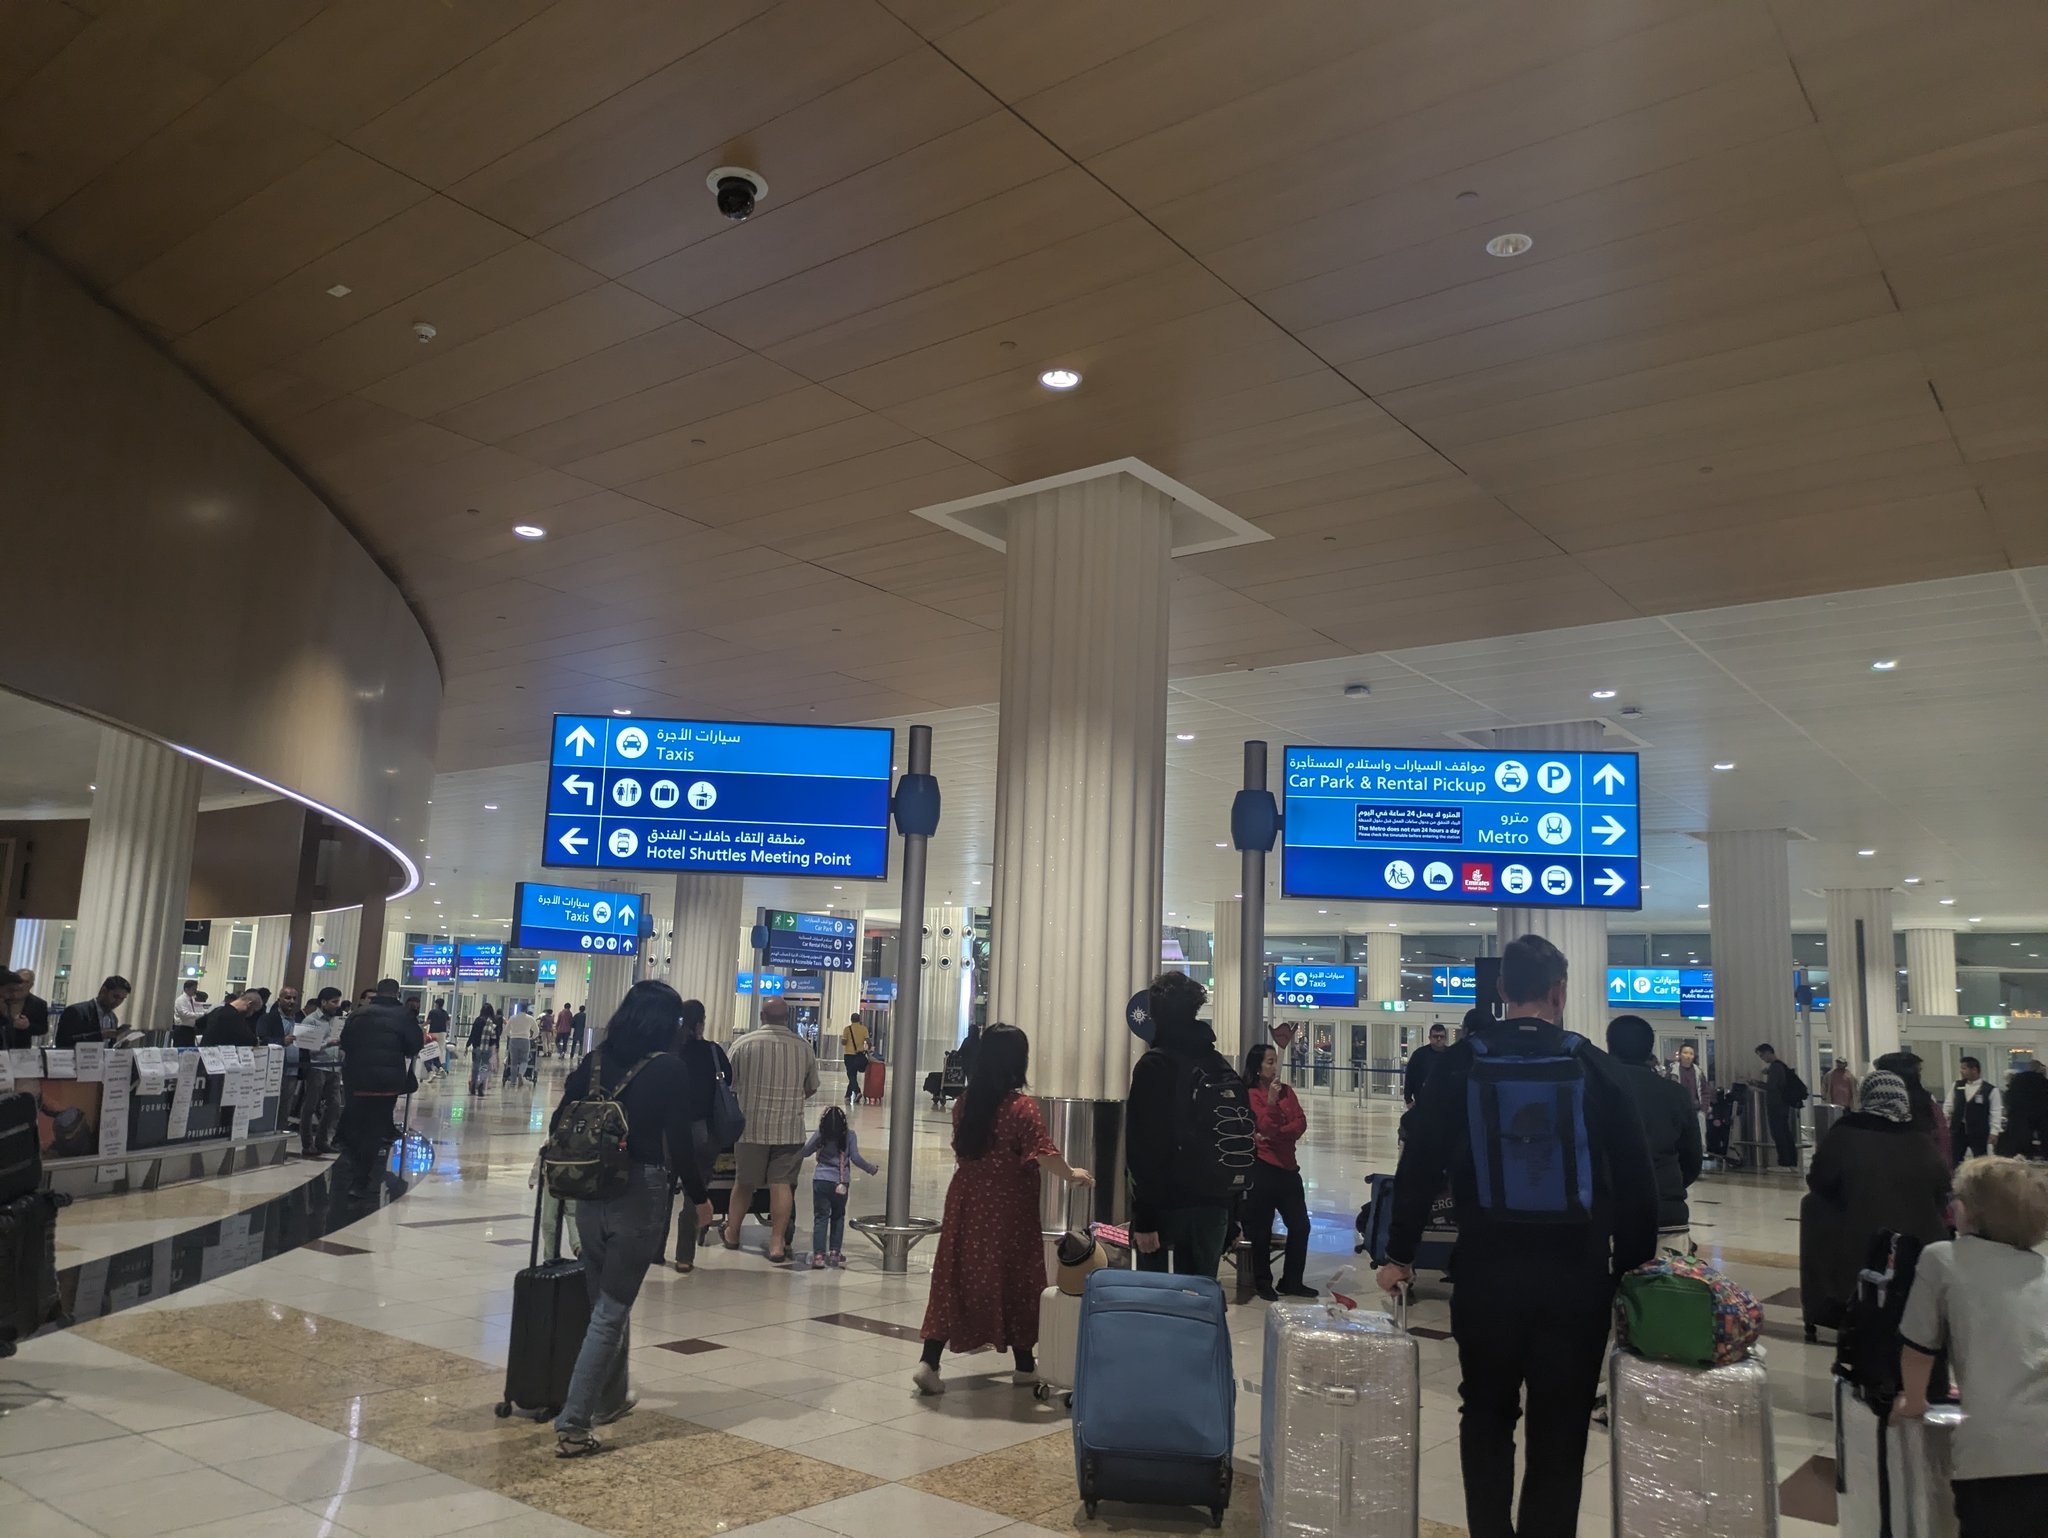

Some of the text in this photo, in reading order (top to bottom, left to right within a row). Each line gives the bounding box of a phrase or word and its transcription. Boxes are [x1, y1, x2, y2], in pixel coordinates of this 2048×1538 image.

[657, 728, 740, 744] سيارات الأجرة
[656, 747, 694, 761] Taxis
[1290, 755, 1342, 769] المستأجرة
[1346, 759, 1391, 773] واستلام
[1445, 761, 1485, 774] مواقف
[1290, 774, 1486, 795] Car Park & Rental Pickup
[1358, 809, 1374, 817] اليوم
[1375, 810, 1387, 818] في
[1501, 813, 1528, 825] مترو
[648, 829, 805, 846] منطقة إلتقاء حافلات الفندق
[1479, 830, 1528, 844] Metro
[647, 846, 851, 867] Hotel Shuttles Meeting Point
[538, 895, 589, 909] سيارات الأجرة
[565, 910, 589, 922] Taxis
[1654, 986, 1680, 994] Car Pa
[141, 1104, 170, 1112] FORMUL
[187, 1128, 216, 1138] PRIMARY
